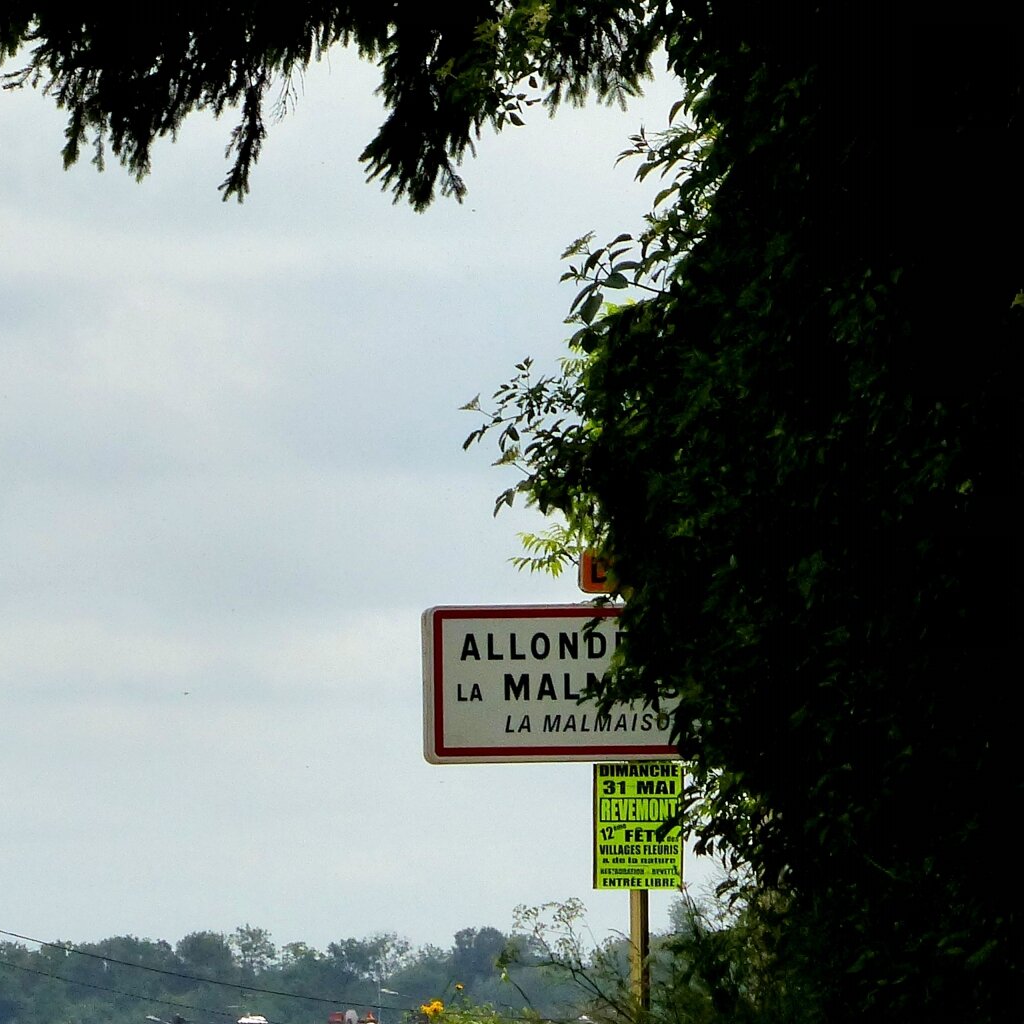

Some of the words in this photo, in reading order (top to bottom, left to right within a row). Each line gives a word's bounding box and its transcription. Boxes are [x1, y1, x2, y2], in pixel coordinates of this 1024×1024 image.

[457, 683, 483, 702] LA
[505, 715, 532, 733] LA
[599, 765, 679, 777] DIMANCHE
[603, 780, 626, 795] 31
[636, 780, 676, 795] MAI
[599, 844, 641, 855] VILLAGES
[643, 844, 679, 855] FLEURIS
[612, 856, 626, 864] de
[602, 877, 642, 887] ENTRÉE
[645, 878, 675, 887] LIBRE
